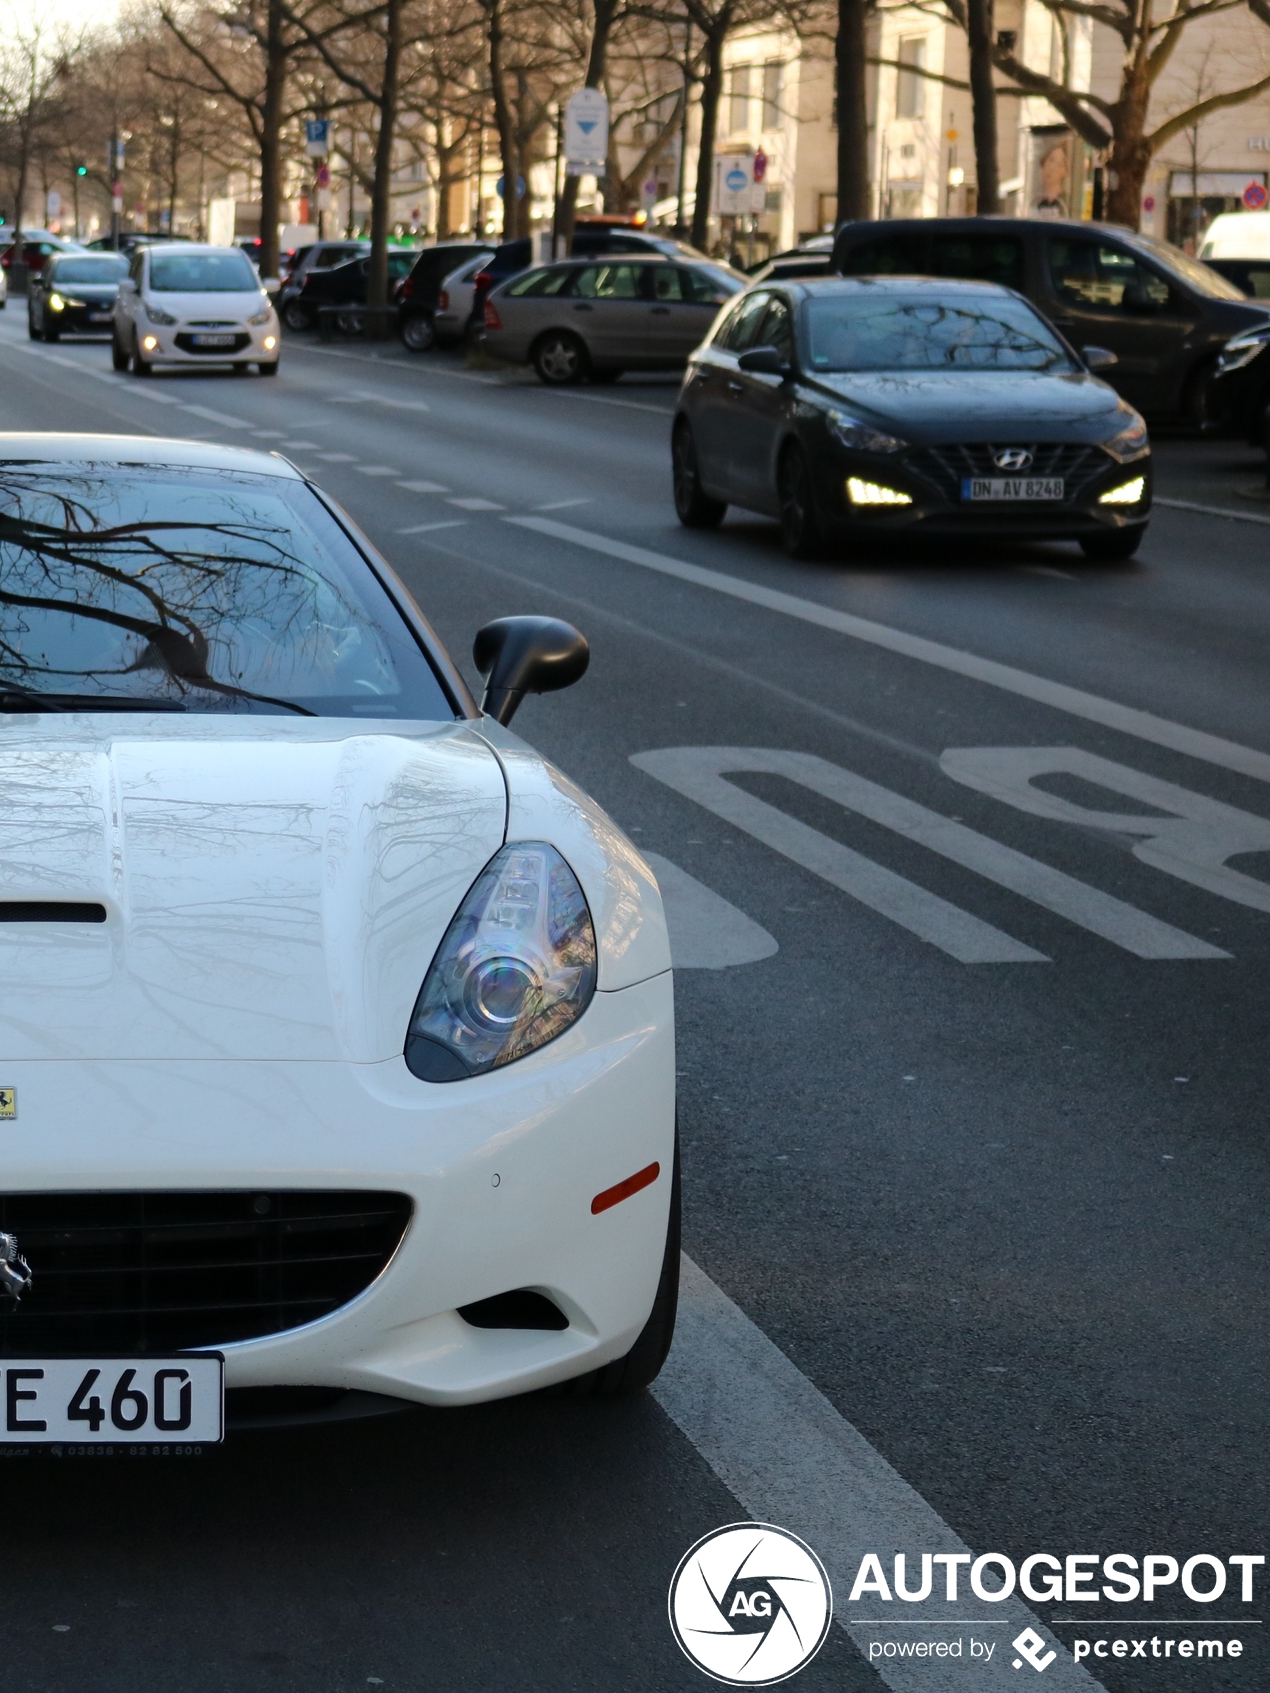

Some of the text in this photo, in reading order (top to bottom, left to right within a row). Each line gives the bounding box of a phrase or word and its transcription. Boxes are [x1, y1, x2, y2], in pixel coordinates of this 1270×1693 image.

[973, 481, 1062, 497] DN AV 8248
[66, 1368, 192, 1432] 460
[68, 1446, 114, 1456] 03838
[129, 1446, 147, 1456] 82
[152, 1446, 169, 1456] 82
[175, 1446, 202, 1456] 500
